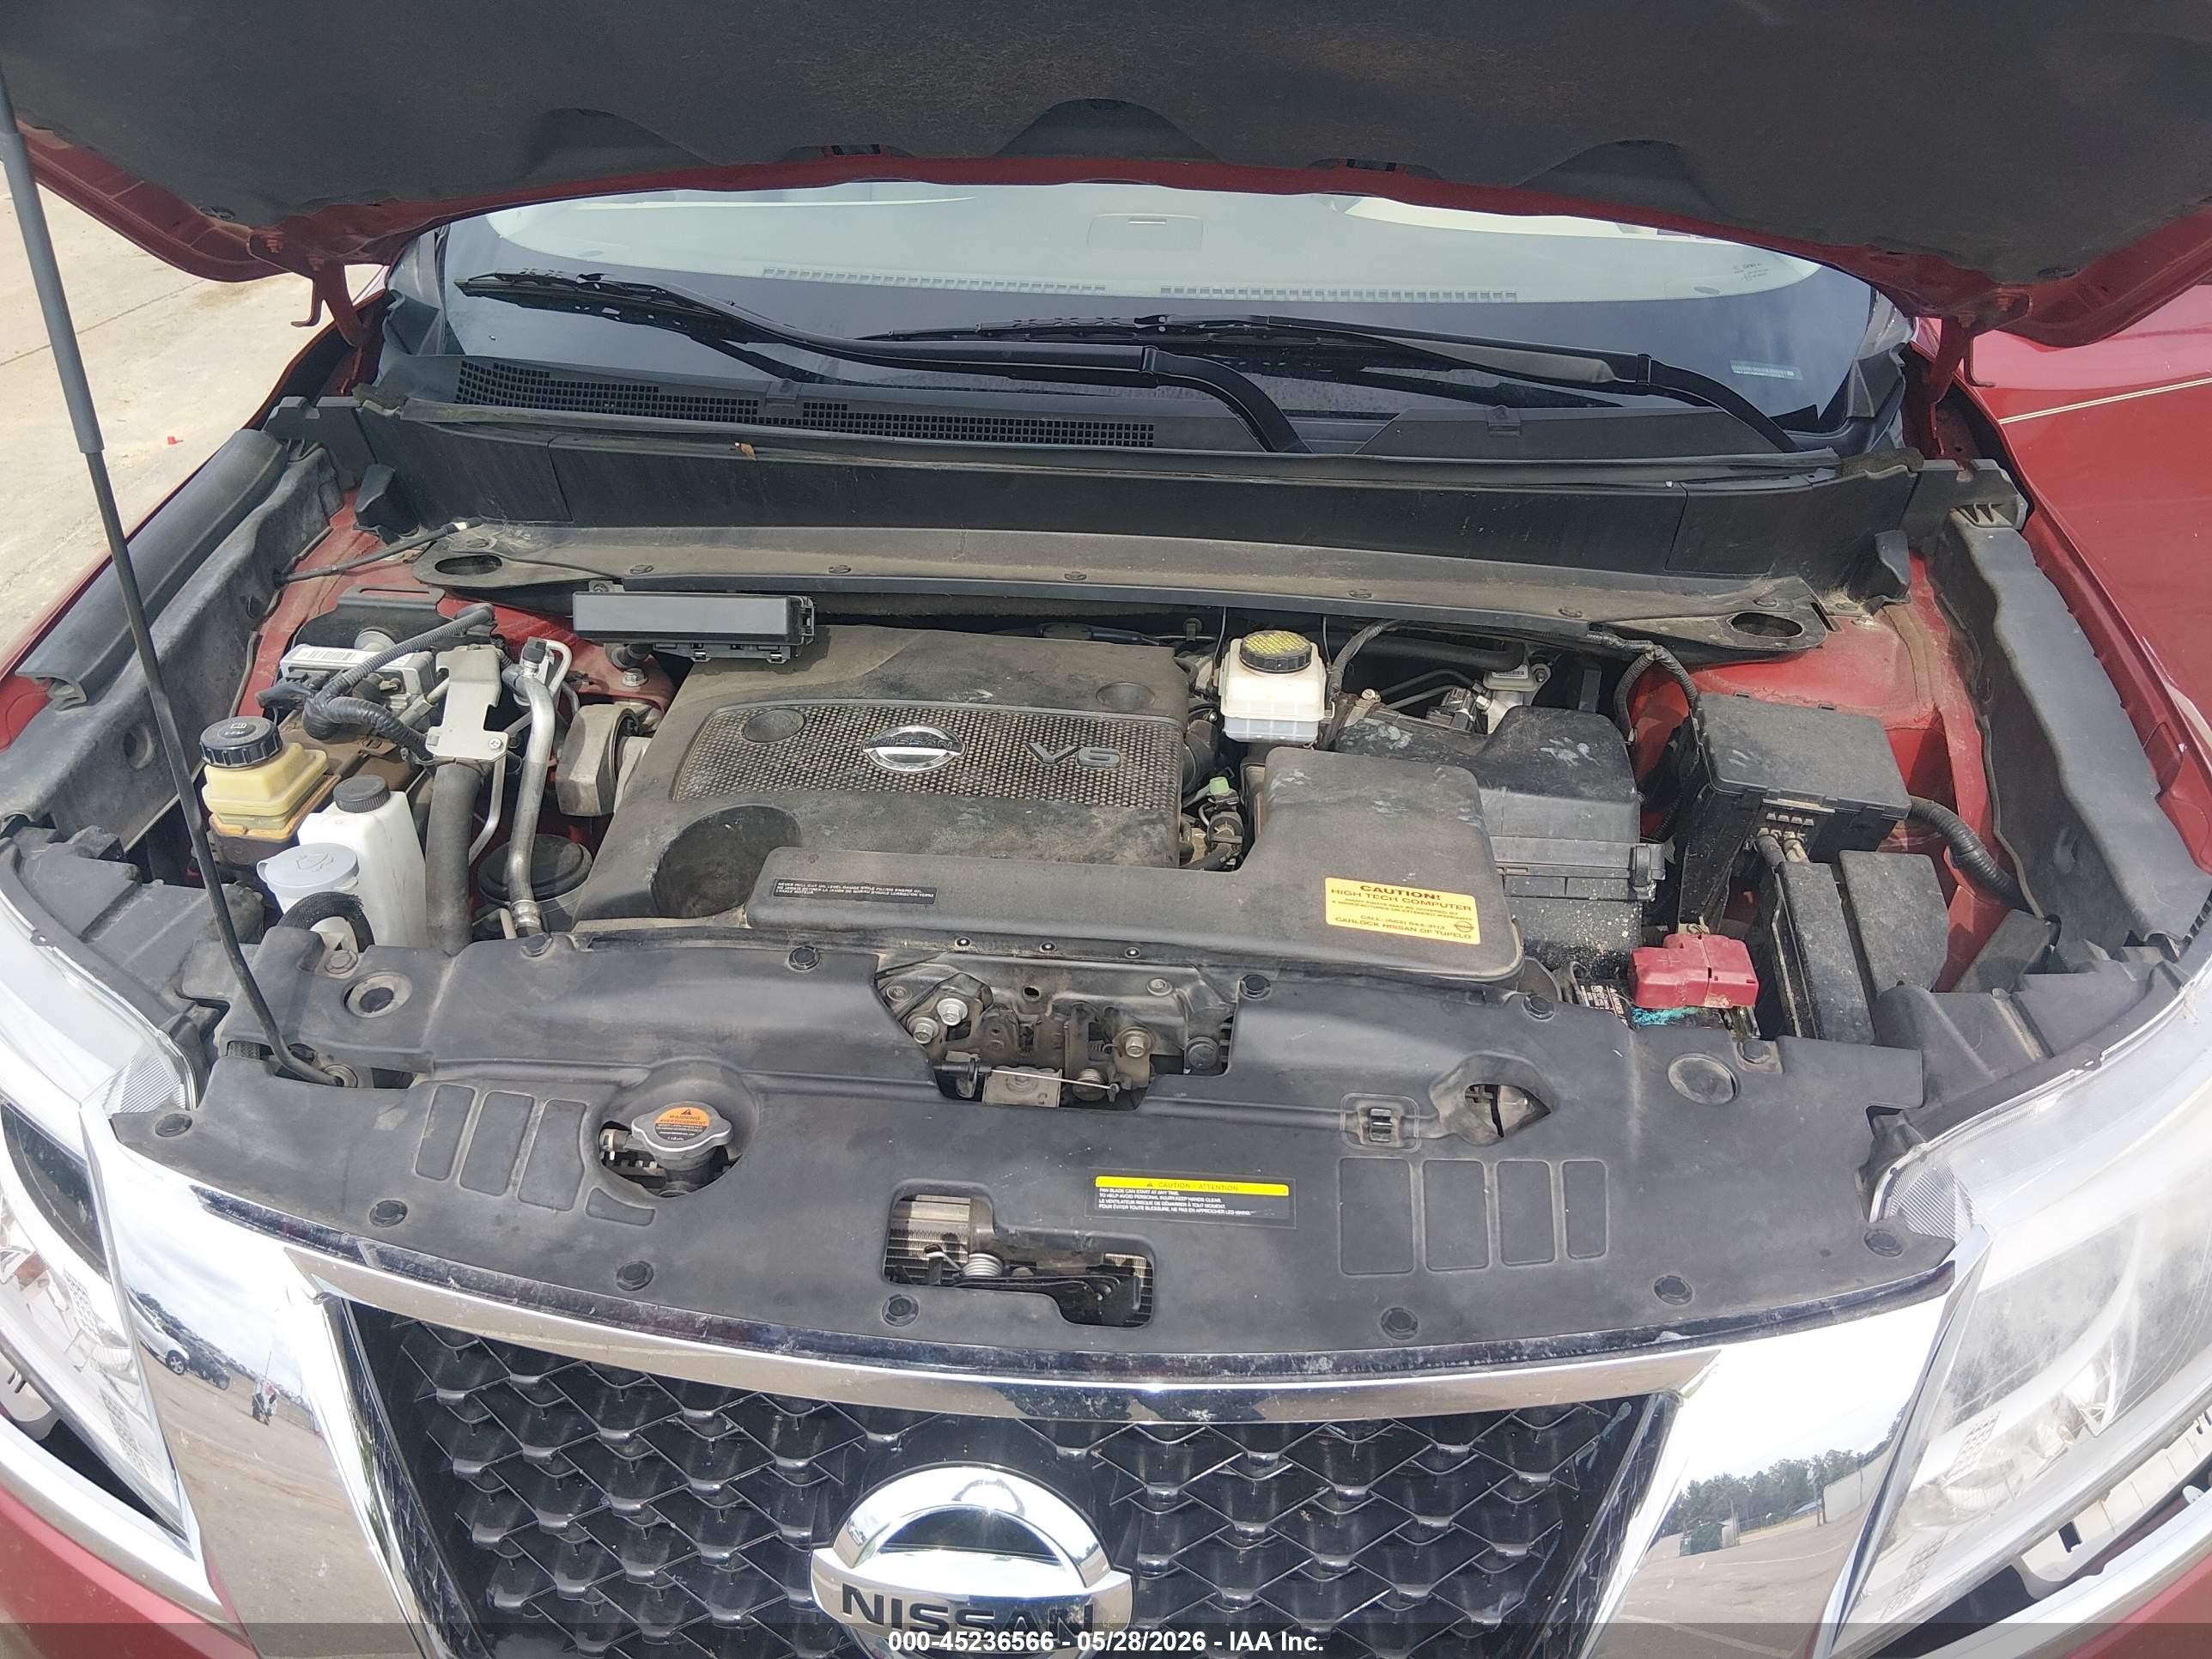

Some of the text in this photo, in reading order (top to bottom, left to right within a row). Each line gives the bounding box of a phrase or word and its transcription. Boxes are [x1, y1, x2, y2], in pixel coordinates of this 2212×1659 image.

[876, 738, 953, 750] NISSAN
[1024, 742, 1121, 769] V6
[1331, 889, 1471, 911] HIGH TECH COMPUTER
[1360, 885, 1440, 900] CAUTION!
[1335, 917, 1380, 927] CARLOCK
[1435, 930, 1471, 939] TUPELO
[842, 1583, 1095, 1641] NISSAN
